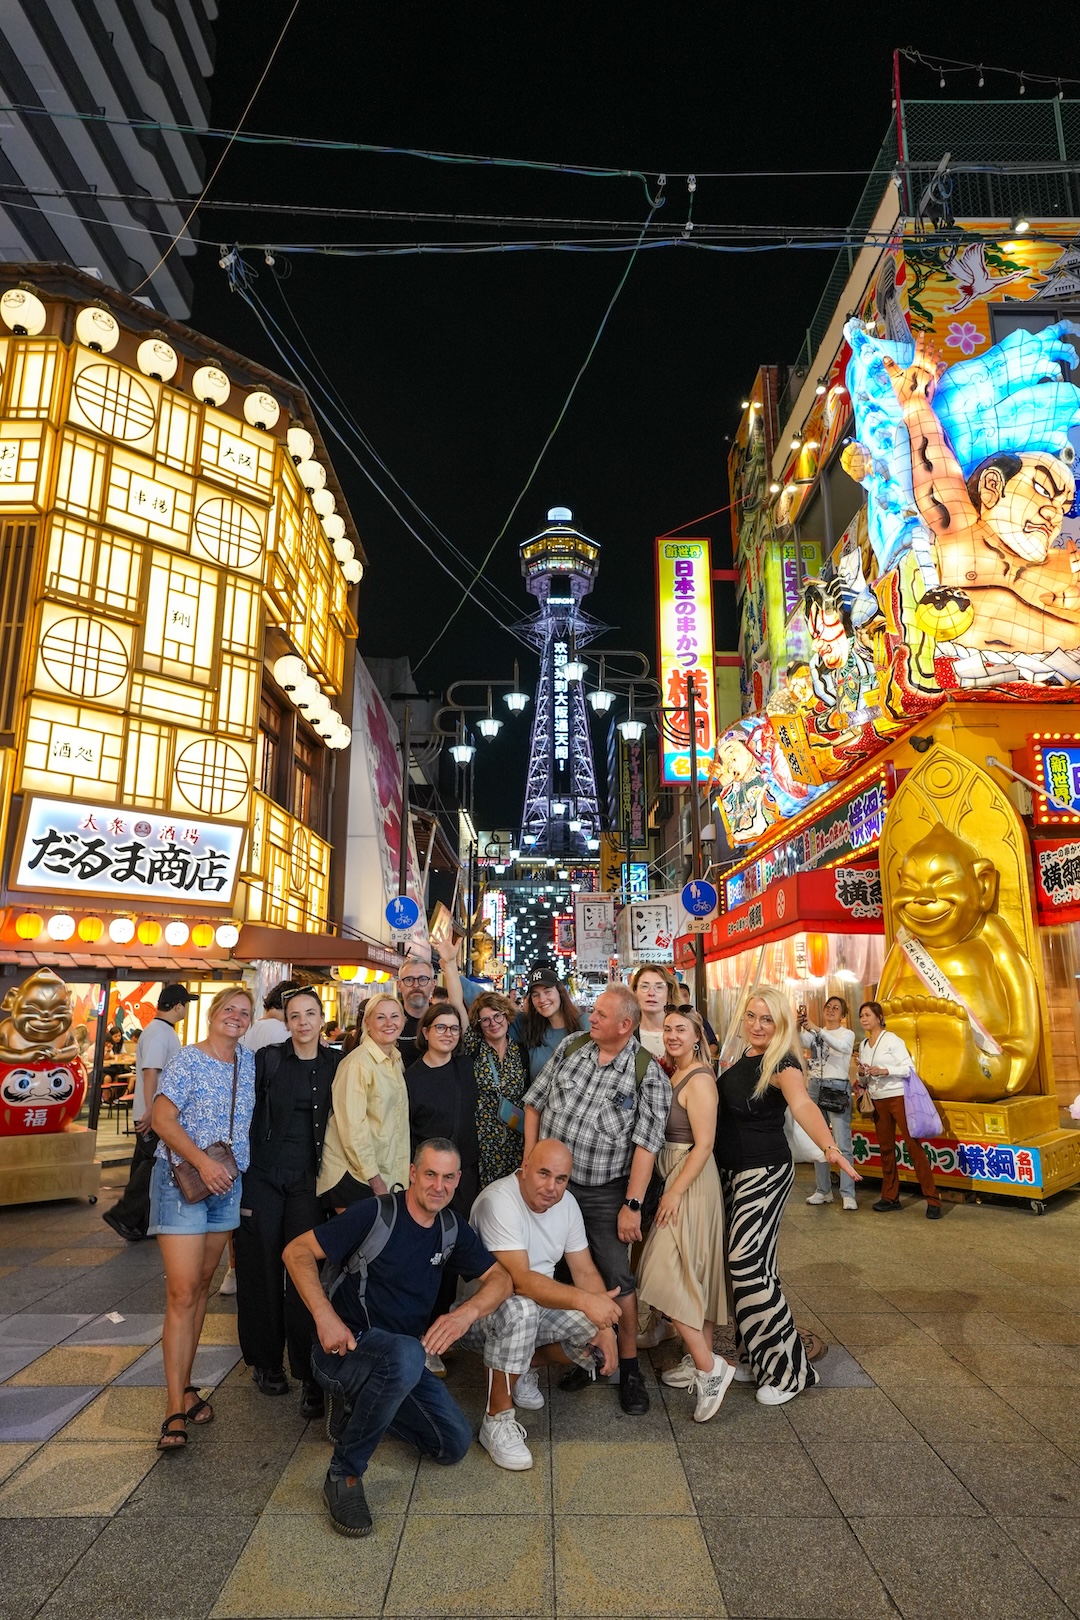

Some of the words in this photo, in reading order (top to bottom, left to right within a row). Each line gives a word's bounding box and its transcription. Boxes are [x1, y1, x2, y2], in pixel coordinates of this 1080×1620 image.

[664, 544, 703, 559] 新世界
[546, 597, 575, 605] HITACHI
[674, 560, 699, 668] 日本一の串かつ
[53, 740, 94, 762] 酒処
[28, 829, 230, 892] だるま商店
[23, 1108, 49, 1128] 福
[957, 1144, 1016, 1180] 横綱
[1016, 1151, 1034, 1182] 名門
